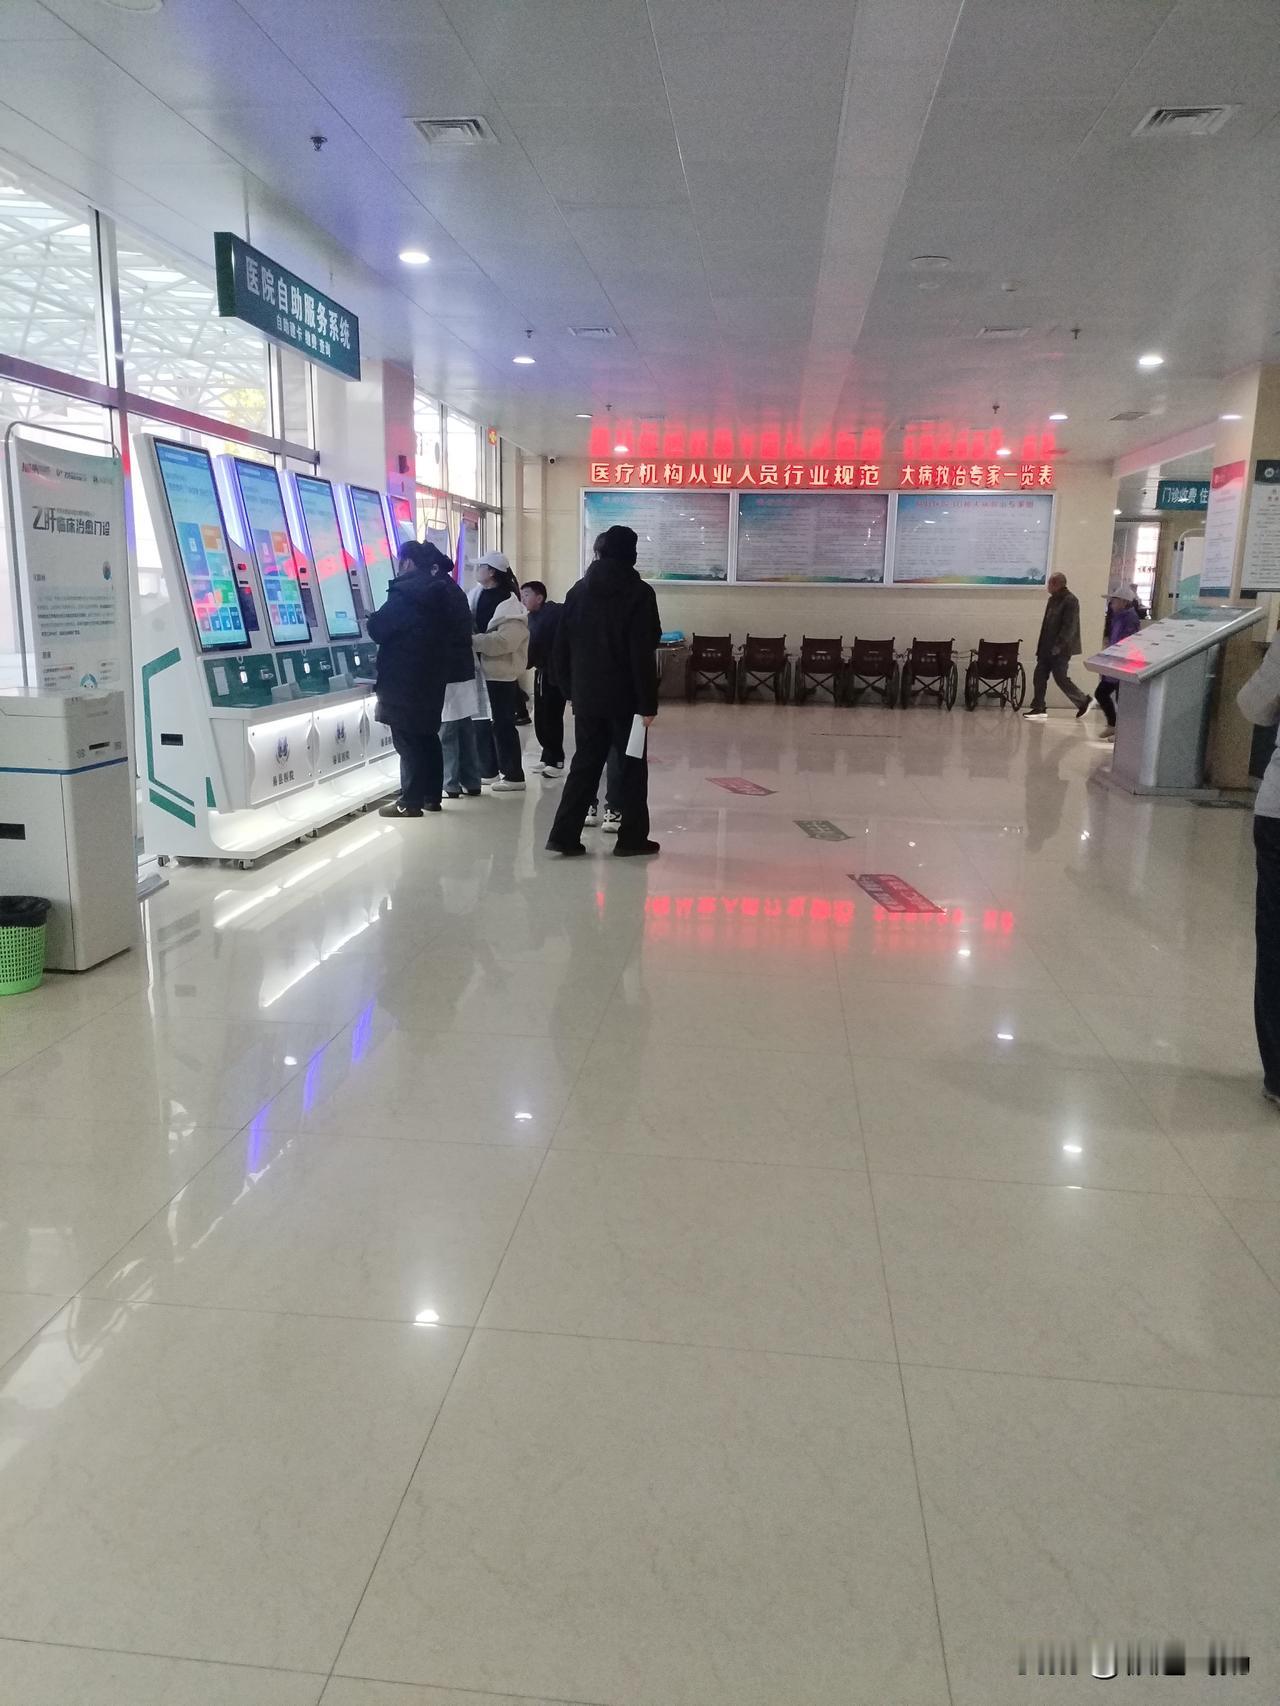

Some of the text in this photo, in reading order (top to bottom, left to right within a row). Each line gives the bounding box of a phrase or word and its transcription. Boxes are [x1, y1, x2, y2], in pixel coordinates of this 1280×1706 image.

[246, 256, 350, 350] 医院自助服务系统
[591, 462, 880, 486] 医疗机构从业人员行业规范
[901, 464, 1054, 486] 大病救治专家一览表
[1162, 487, 1197, 504] 门诊收费
